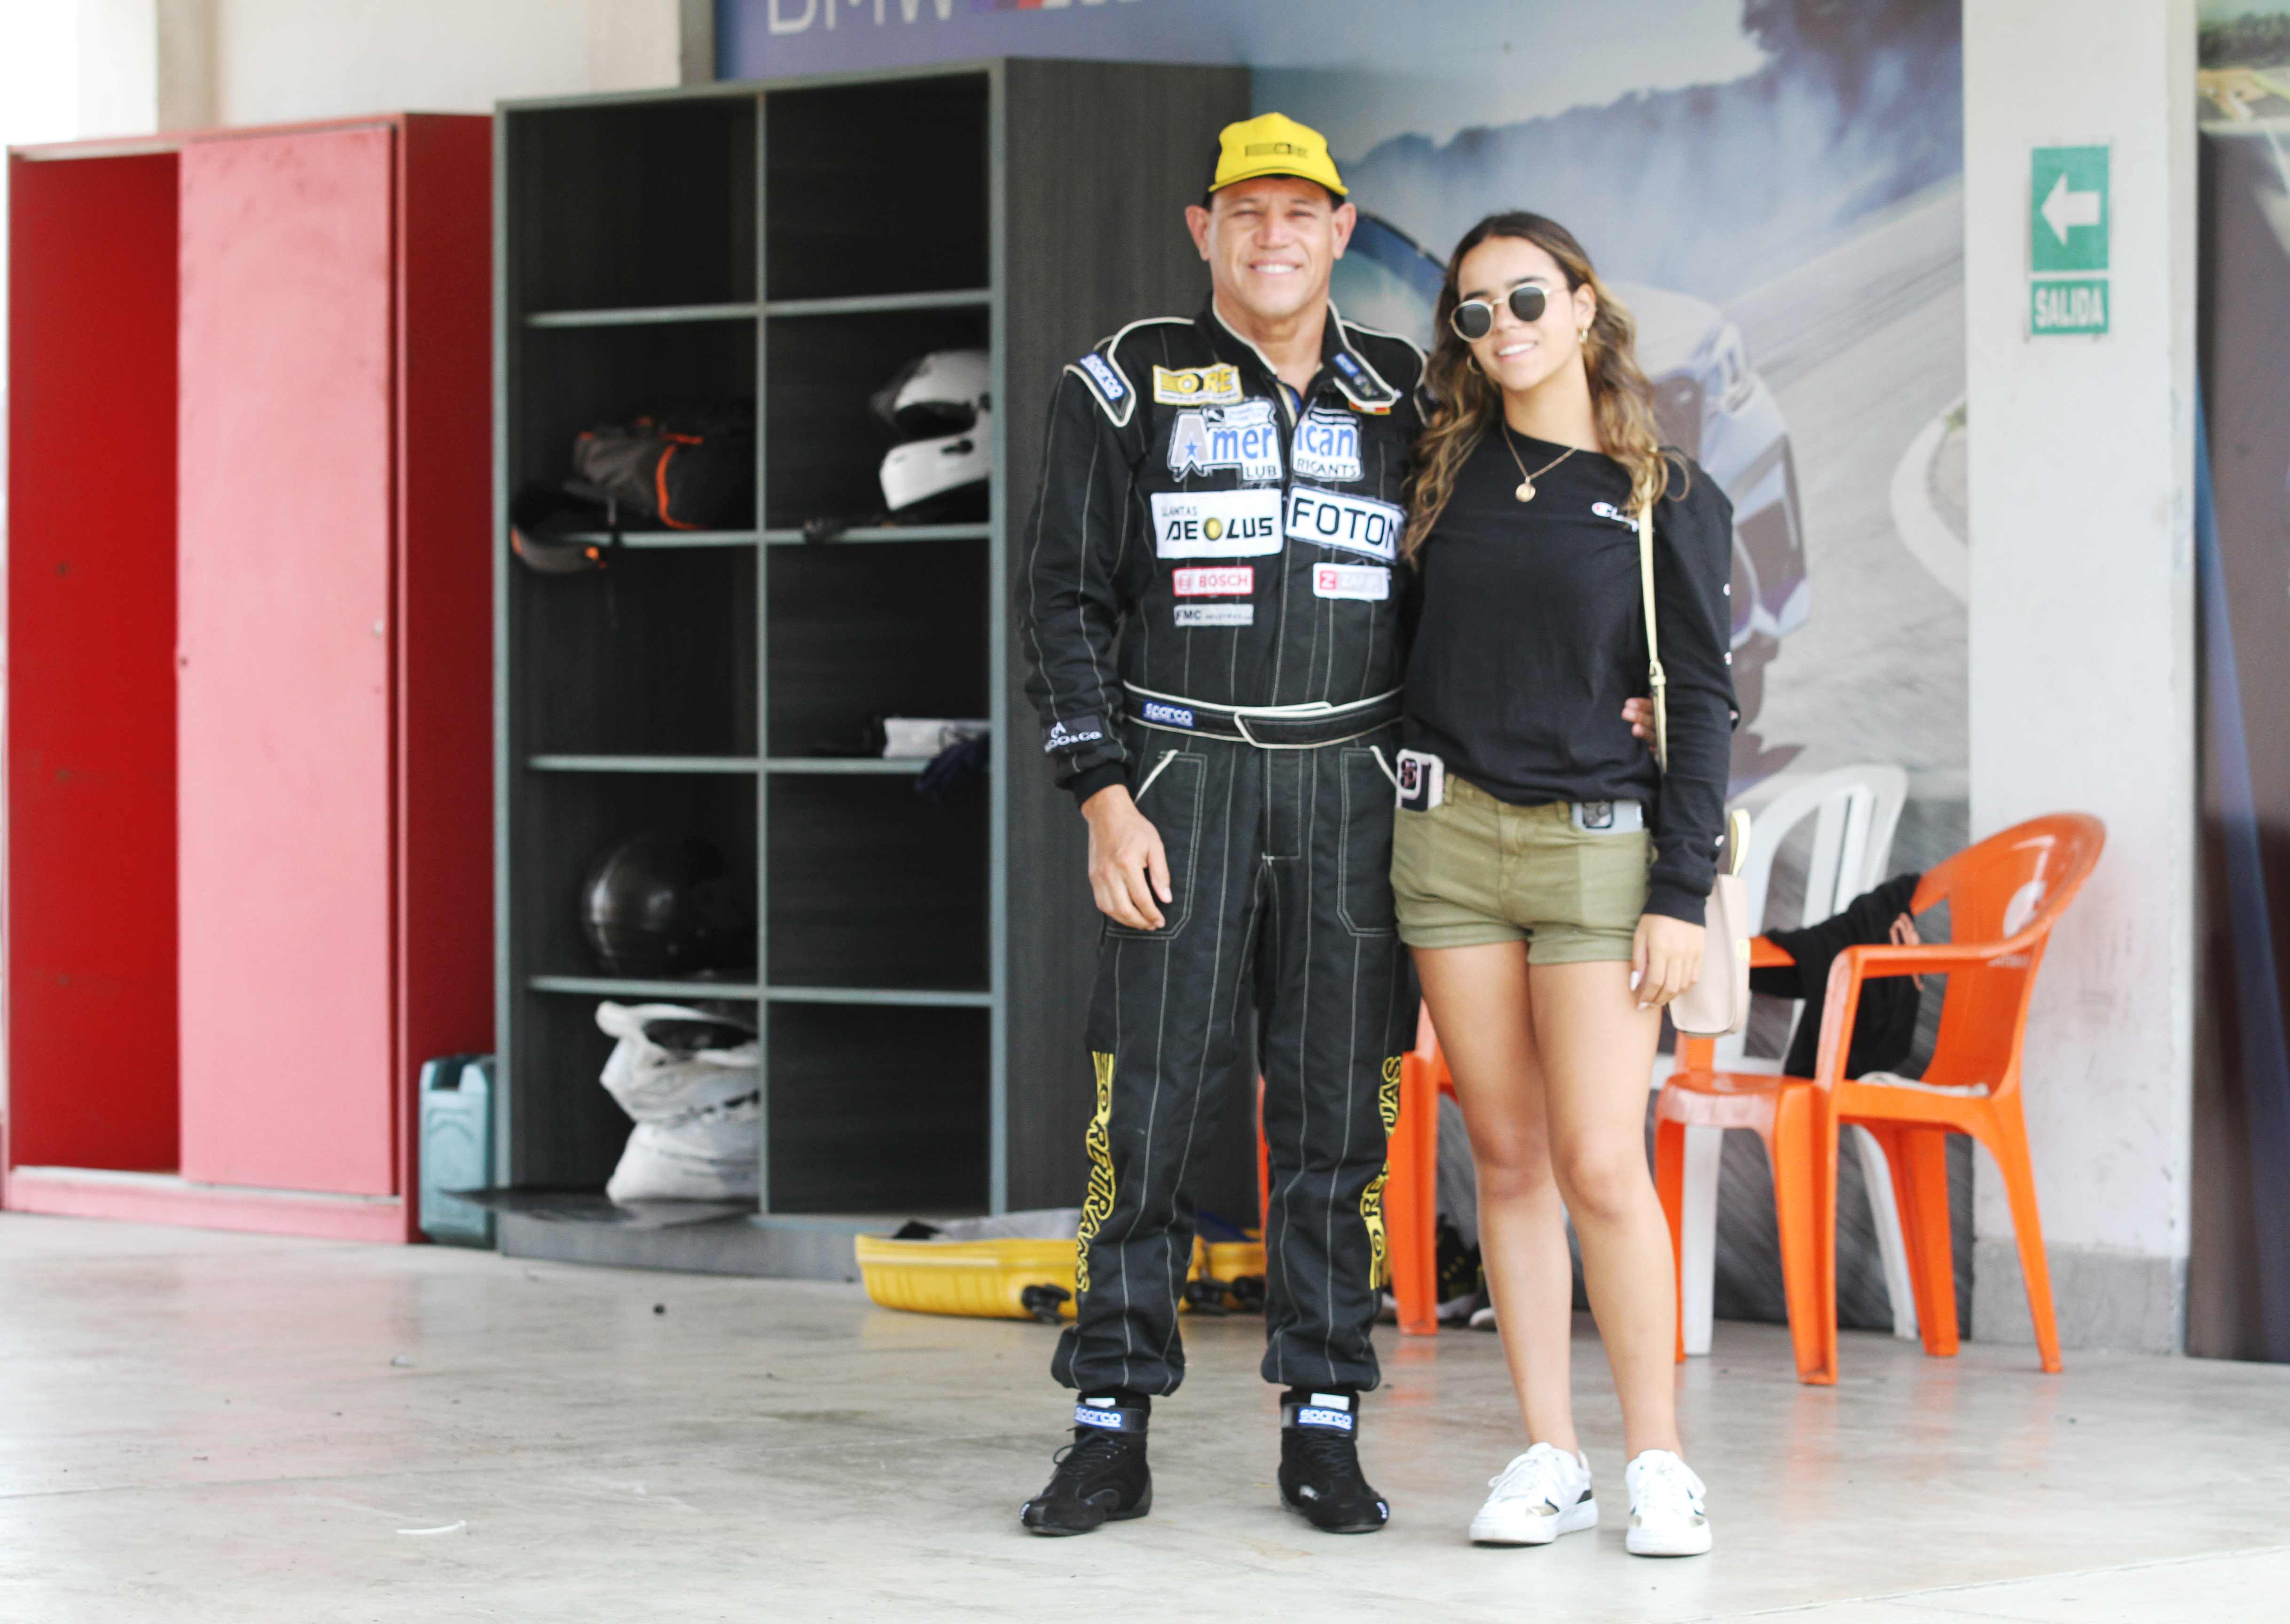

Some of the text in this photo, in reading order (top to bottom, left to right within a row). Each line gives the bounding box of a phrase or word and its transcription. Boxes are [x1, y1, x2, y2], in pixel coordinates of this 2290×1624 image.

[2035, 287, 2105, 328] SALIDA
[1199, 574, 1248, 587] BOSCH
[1299, 1409, 1352, 1429] sparco
